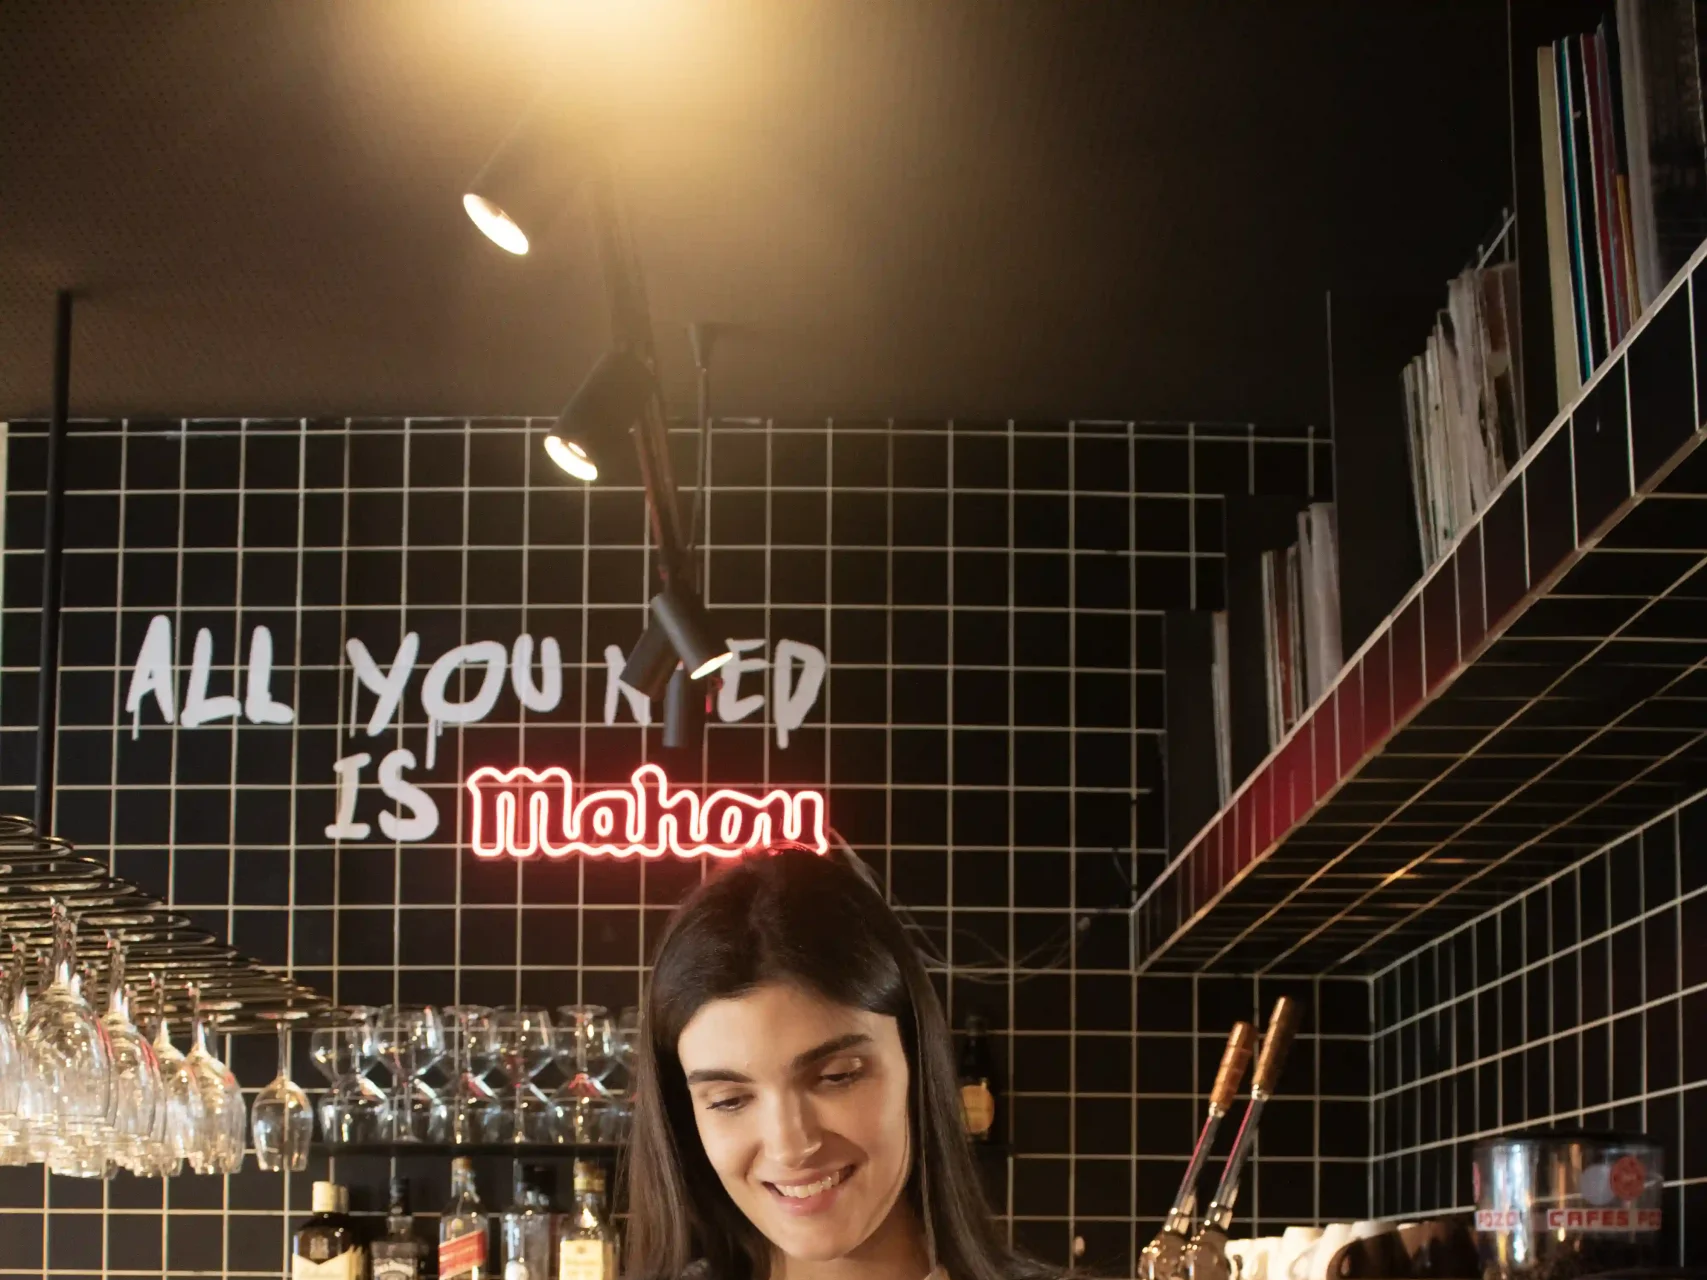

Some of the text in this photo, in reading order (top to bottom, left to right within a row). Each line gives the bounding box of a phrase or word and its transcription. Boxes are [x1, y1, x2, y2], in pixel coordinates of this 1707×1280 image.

[125, 614, 826, 769] ALL YOU NED
[324, 748, 439, 841] IS
